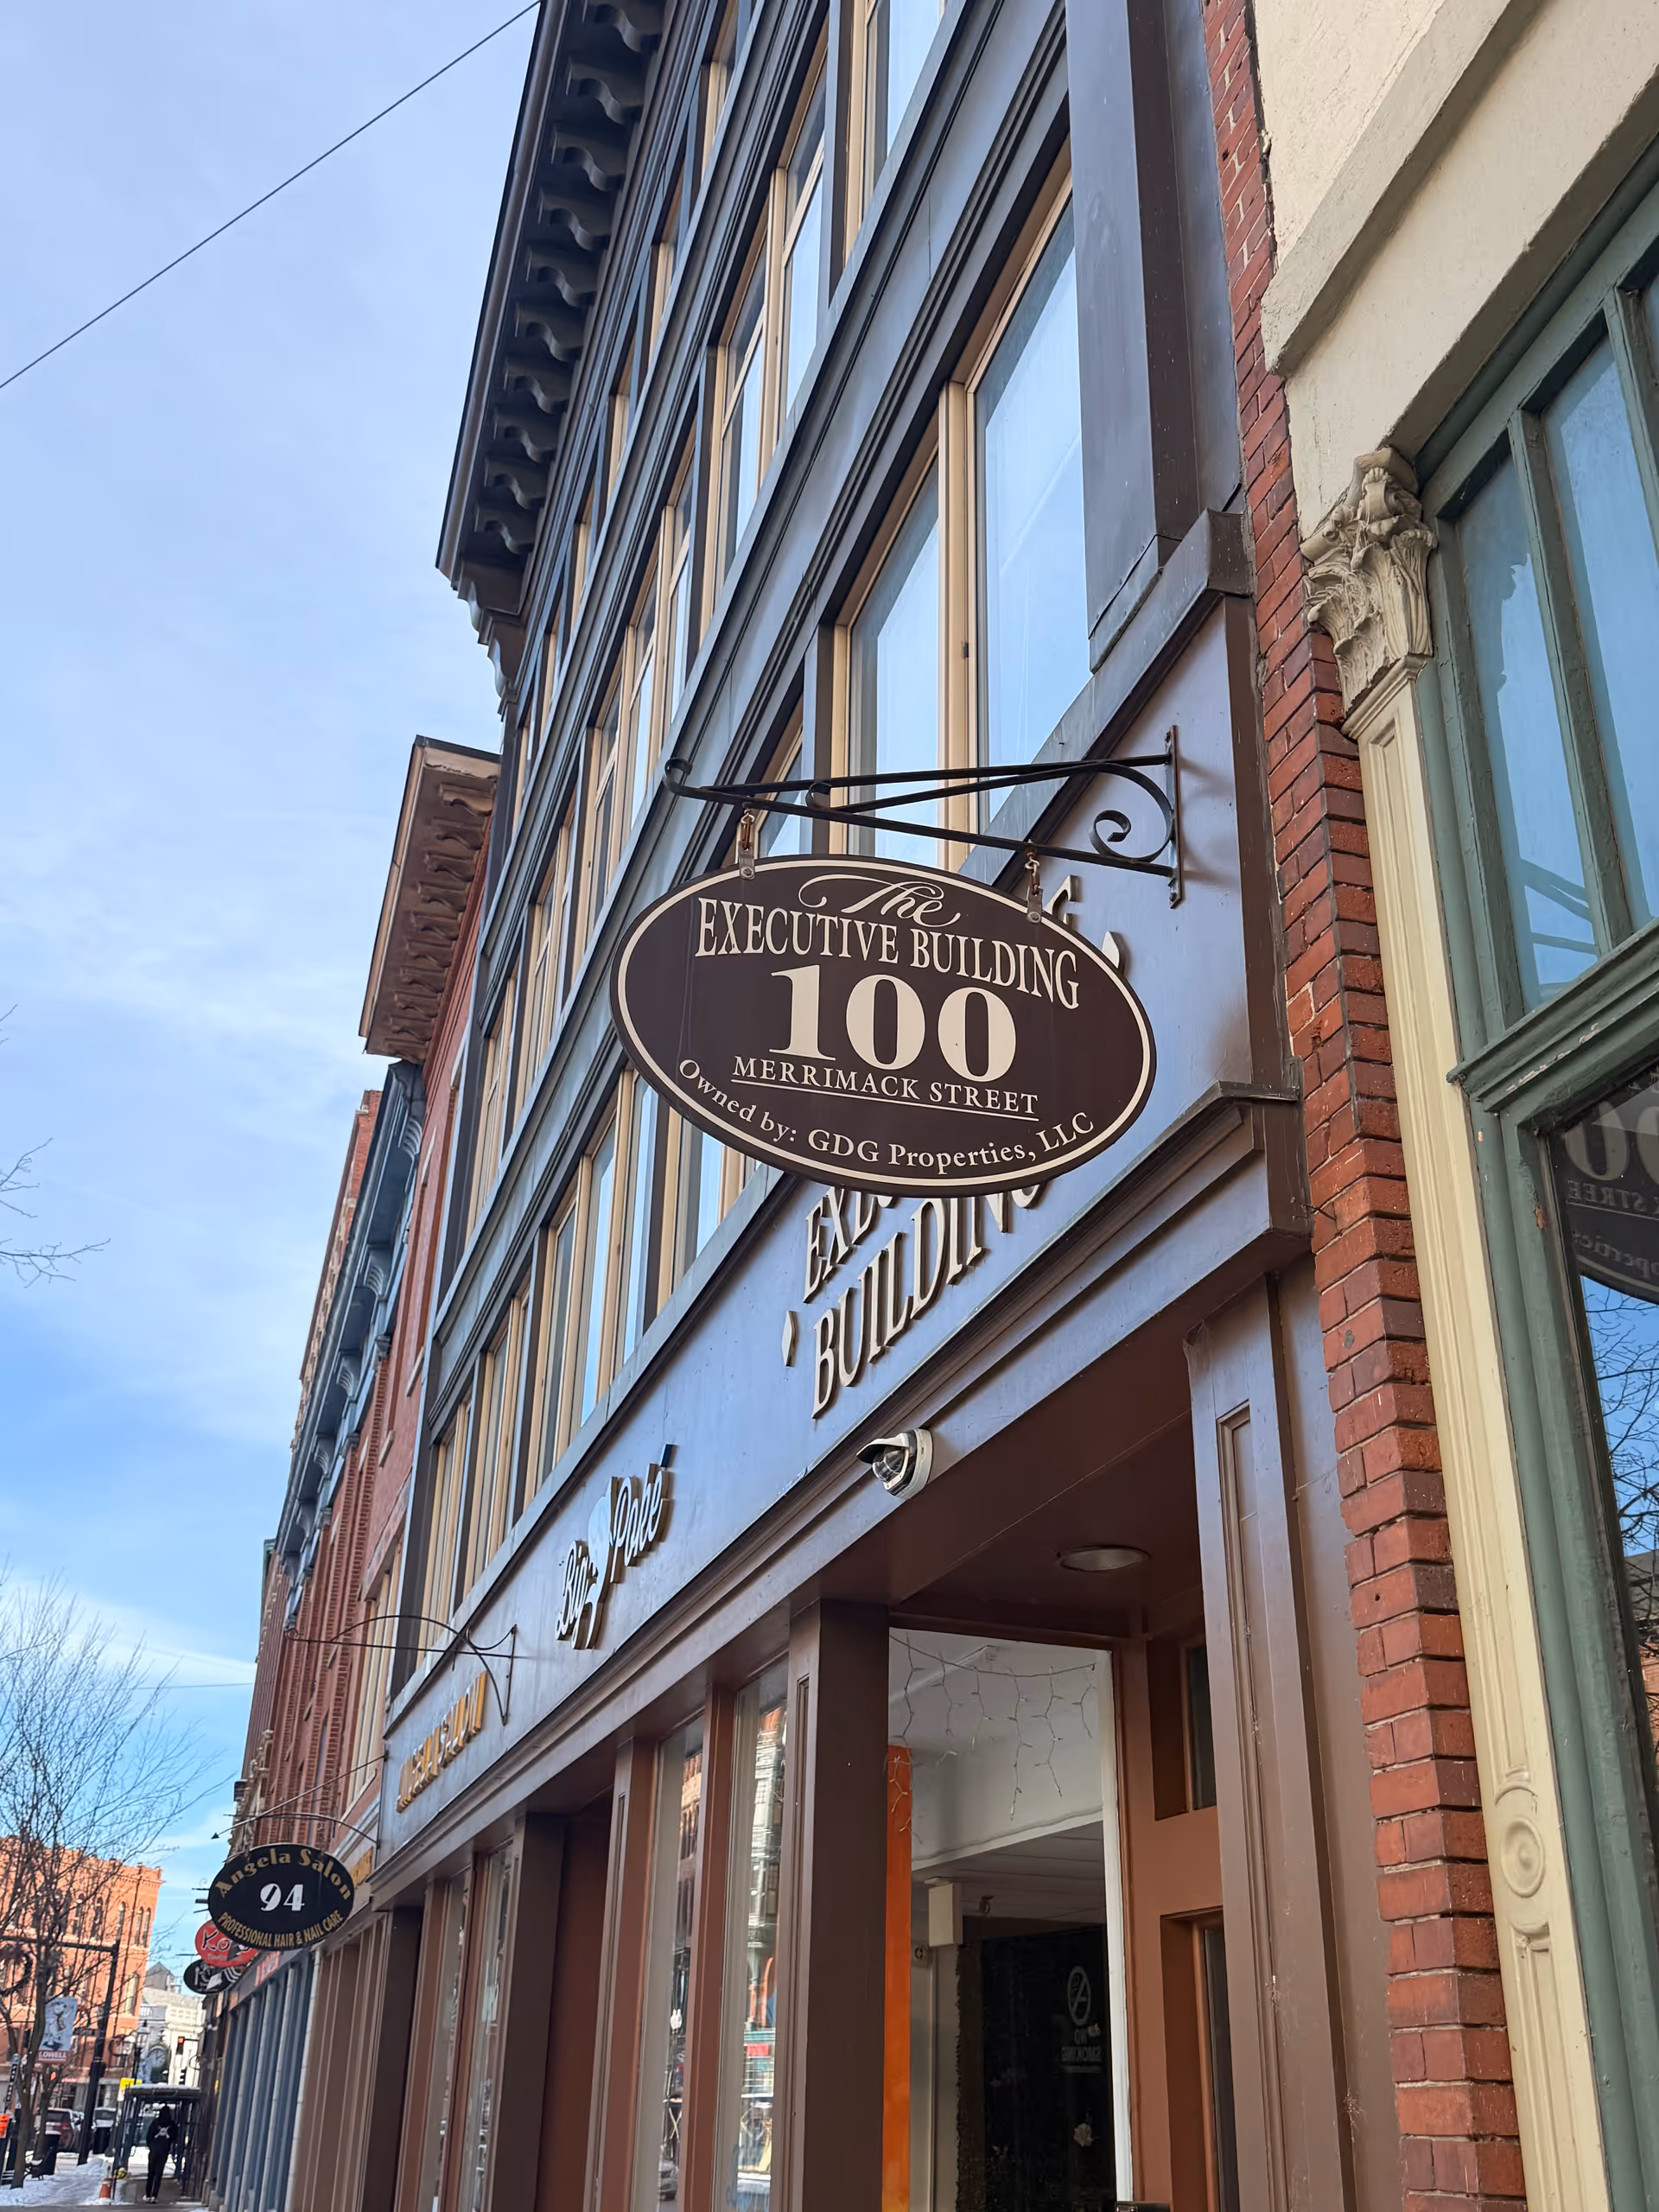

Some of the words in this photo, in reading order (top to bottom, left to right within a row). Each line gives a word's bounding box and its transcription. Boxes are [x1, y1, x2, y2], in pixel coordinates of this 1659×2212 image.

[798, 874, 961, 927] The
[695, 897, 898, 965] EXECUTIVE
[910, 928, 1080, 1009] BUILDING
[770, 964, 1017, 1083] 100
[732, 1055, 920, 1101] MERRIMACK
[930, 1082, 1039, 1116] STREET
[679, 1058, 757, 1120] Owned
[760, 1109, 797, 1142] by:
[808, 1128, 880, 1163] GDG
[888, 1141, 1037, 1174] Properties,
[1037, 1111, 1094, 1152] LLC
[215, 1847, 291, 1898] Angela
[298, 1848, 352, 1901] Salon
[260, 1883, 305, 1911] 94
[218, 1911, 271, 1948] PROFESSIONAL
[274, 1933, 294, 1948] HAIR
[296, 1931, 302, 1944] &
[304, 1926, 325, 1942] NAIL
[322, 1910, 343, 1934] CARE
